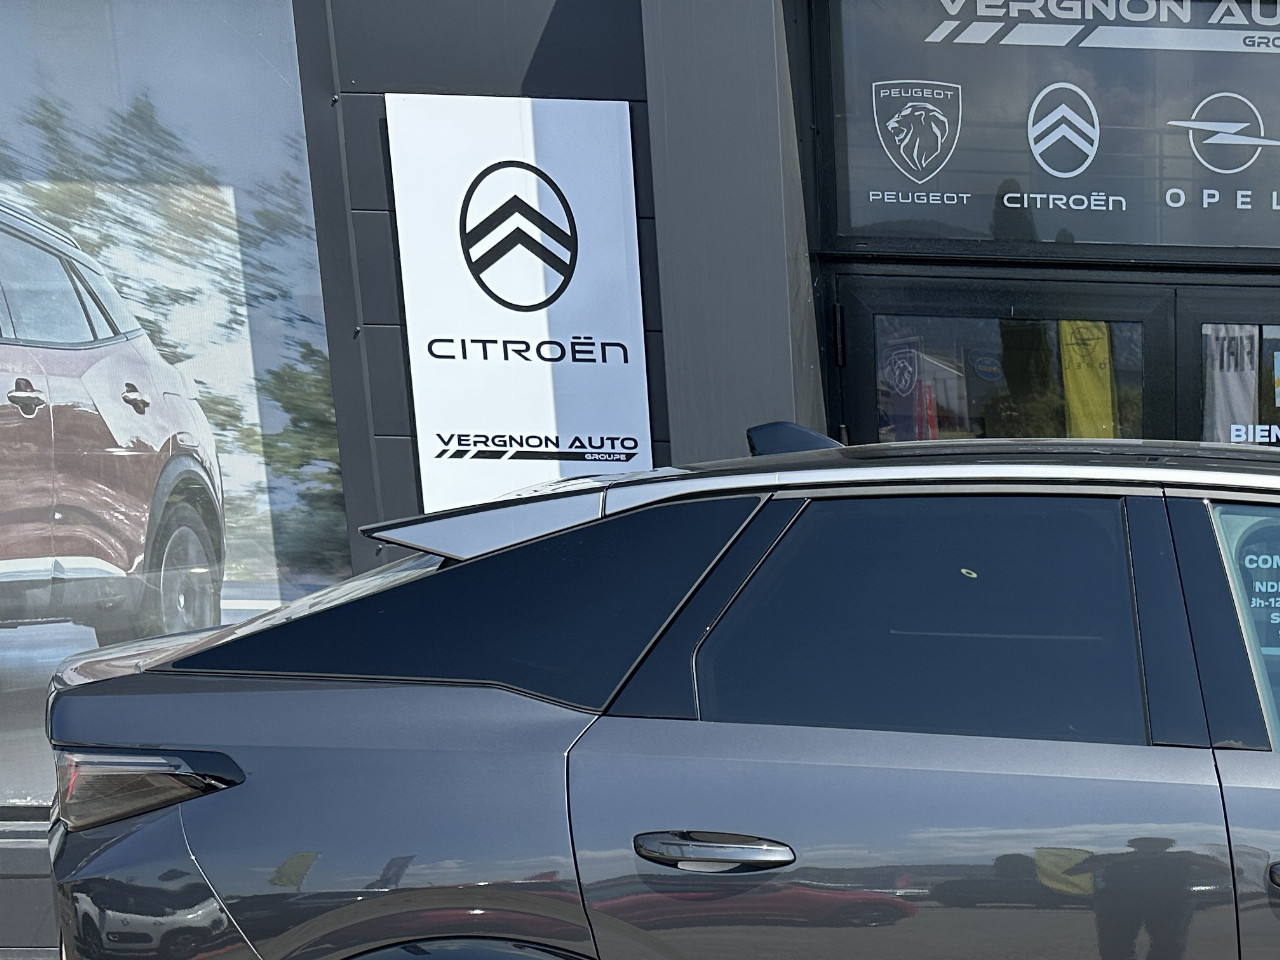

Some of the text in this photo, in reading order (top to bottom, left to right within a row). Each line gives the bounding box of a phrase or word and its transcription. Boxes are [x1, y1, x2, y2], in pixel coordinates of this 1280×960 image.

[937, 0, 1191, 24] VERGNON
[880, 88, 954, 100] PEUGEOT
[869, 191, 972, 205] PEUGEOT
[435, 433, 639, 451] VERGNON AUTO
[584, 453, 627, 461] GROUPE
